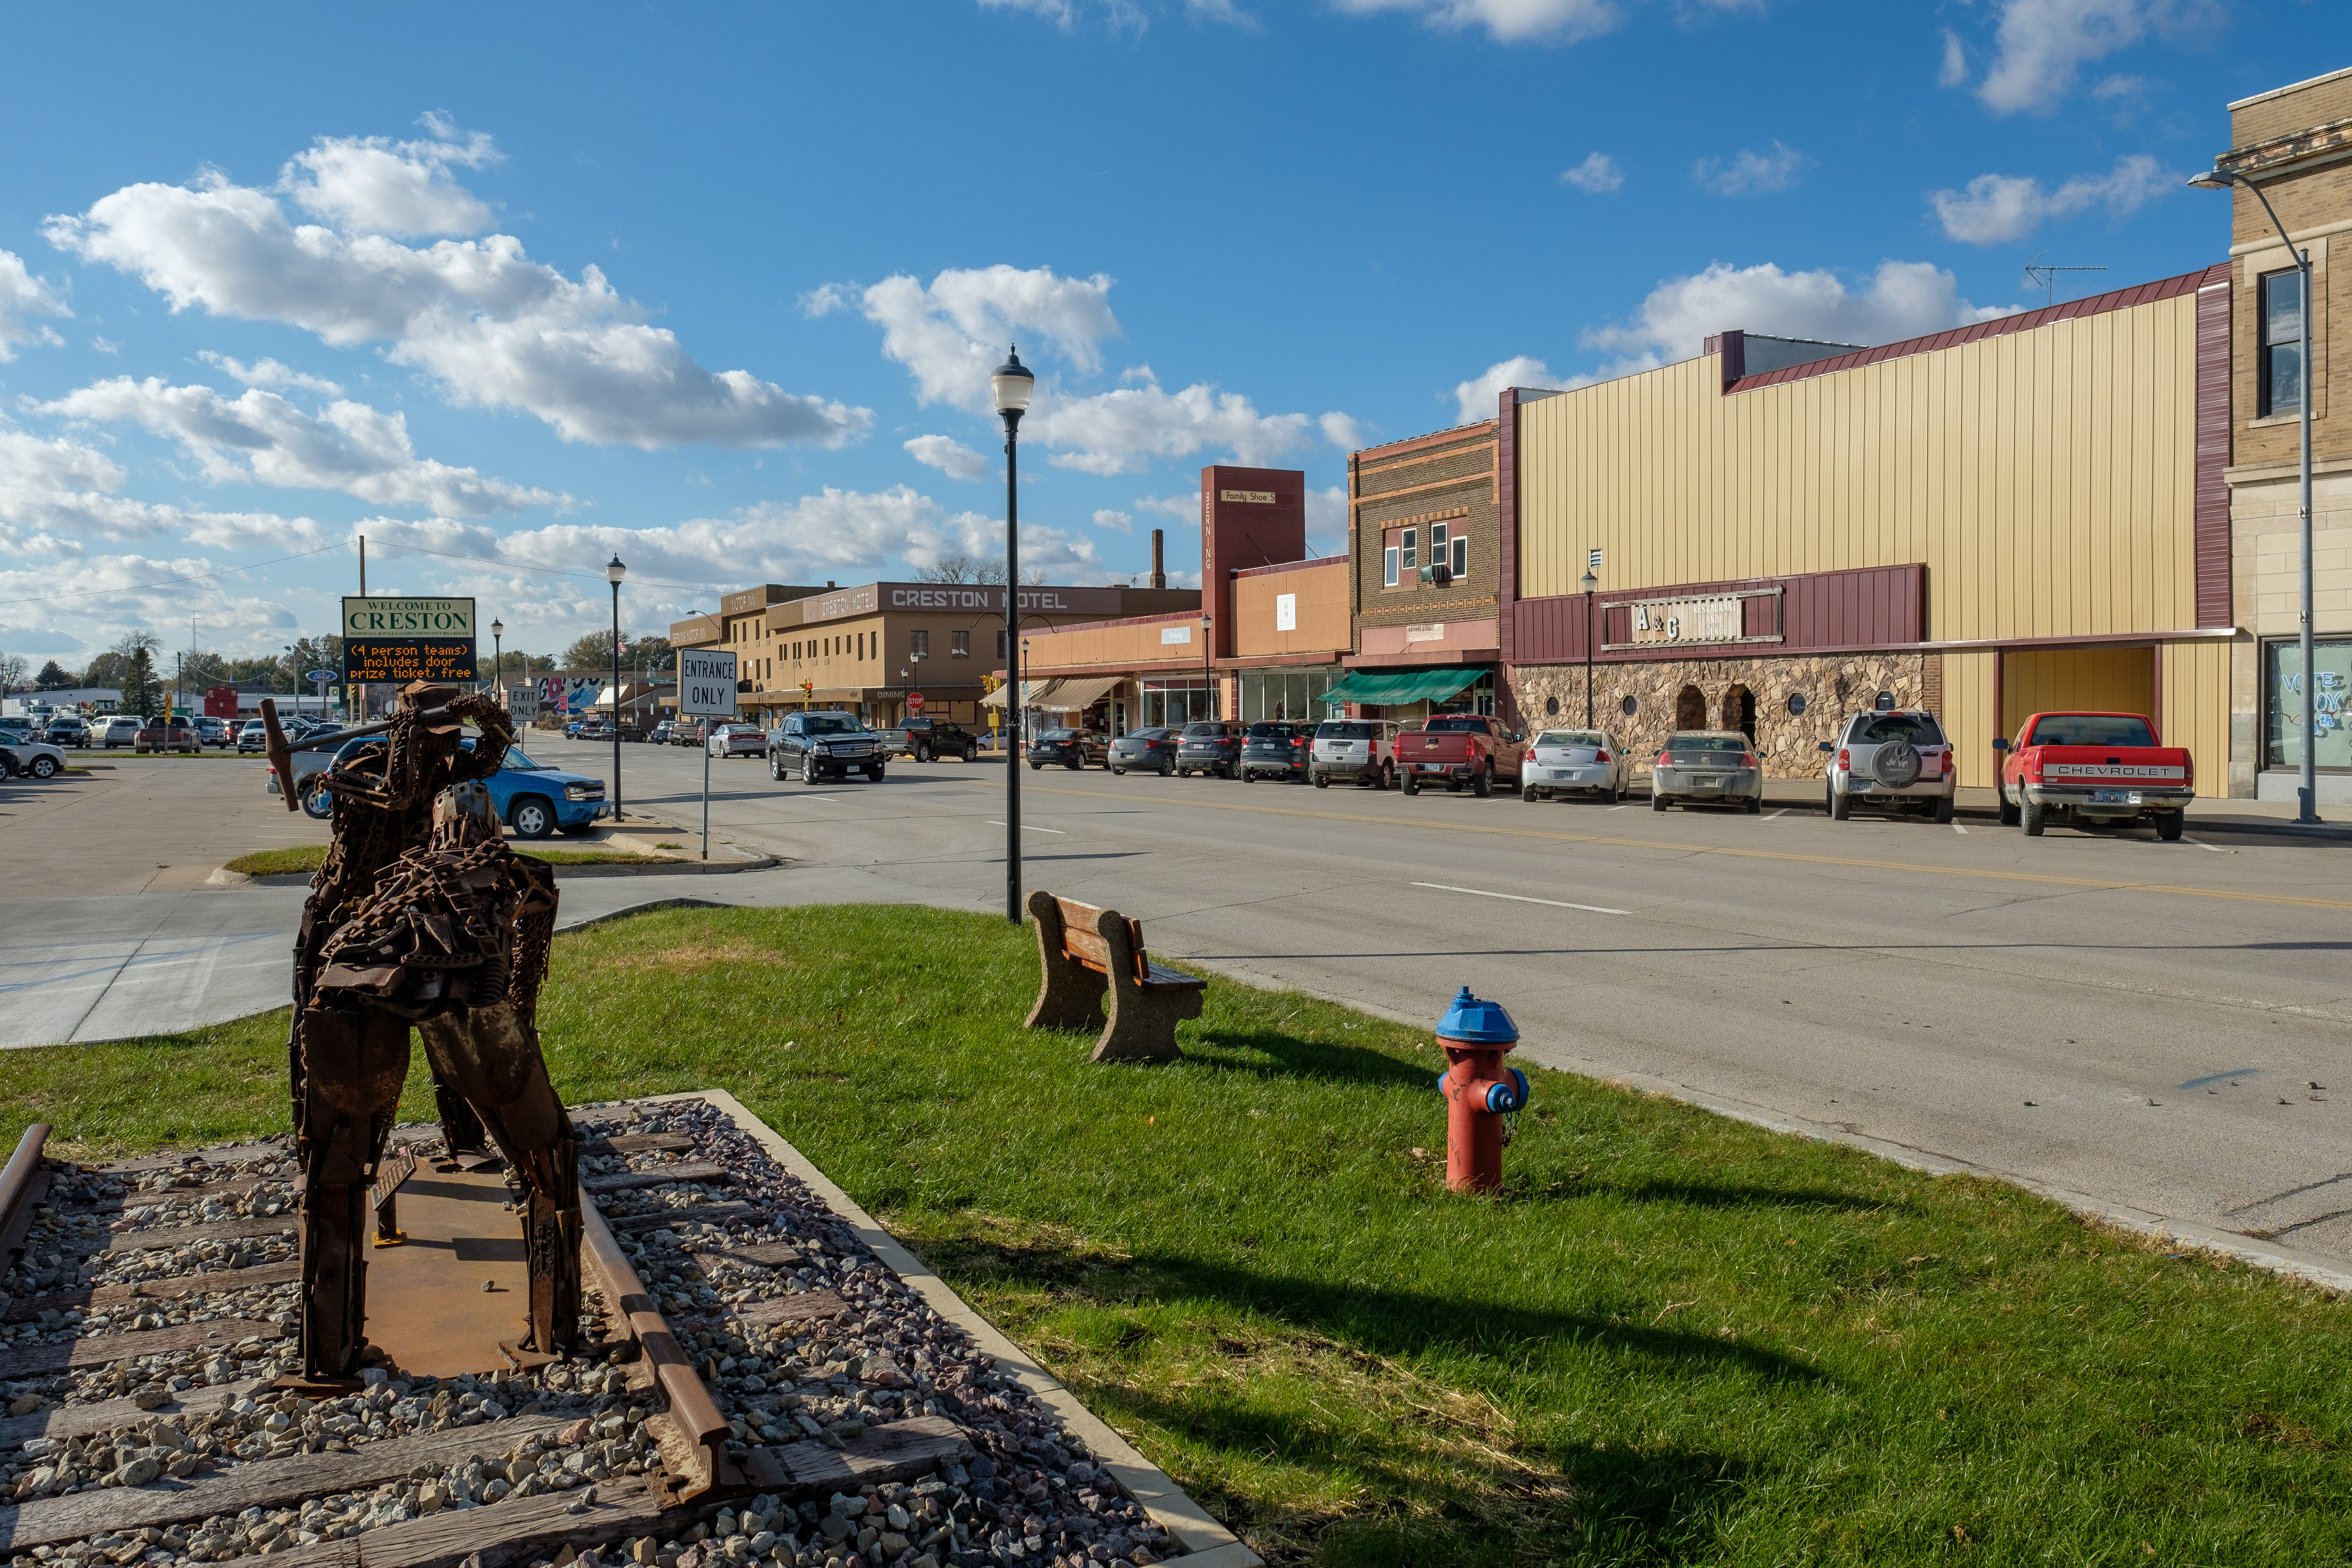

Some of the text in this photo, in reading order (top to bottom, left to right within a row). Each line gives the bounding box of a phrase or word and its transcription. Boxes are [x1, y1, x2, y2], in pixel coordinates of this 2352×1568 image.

[1227, 491, 1247, 502] Family
[1250, 492, 1267, 501] Shoe
[731, 593, 755, 611] MOTOR INN
[822, 591, 874, 616] CRESTON MOTEL
[892, 590, 988, 607] CRESTON
[367, 602, 451, 610] WELCOME TO
[1693, 602, 1737, 613] RESTAURANT
[350, 612, 468, 630] CRESTON
[1637, 608, 1679, 639] A & G
[1705, 615, 1719, 624] AND
[672, 631, 686, 644] BERNING
[687, 628, 699, 642] MOTOR
[1702, 626, 1728, 636] LOUNGE
[351, 644, 467, 655] (4 person teams)
[364, 656, 456, 667] includes door
[350, 668, 386, 679] prize
[441, 667, 471, 678] free
[685, 659, 733, 680] ENTRANCE
[513, 691, 536, 702] EXIT
[692, 686, 725, 705] ONLY
[511, 705, 537, 716] ONLY
[1886, 758, 1908, 768] Jeep
[2058, 766, 2171, 776] CHEVROLET
